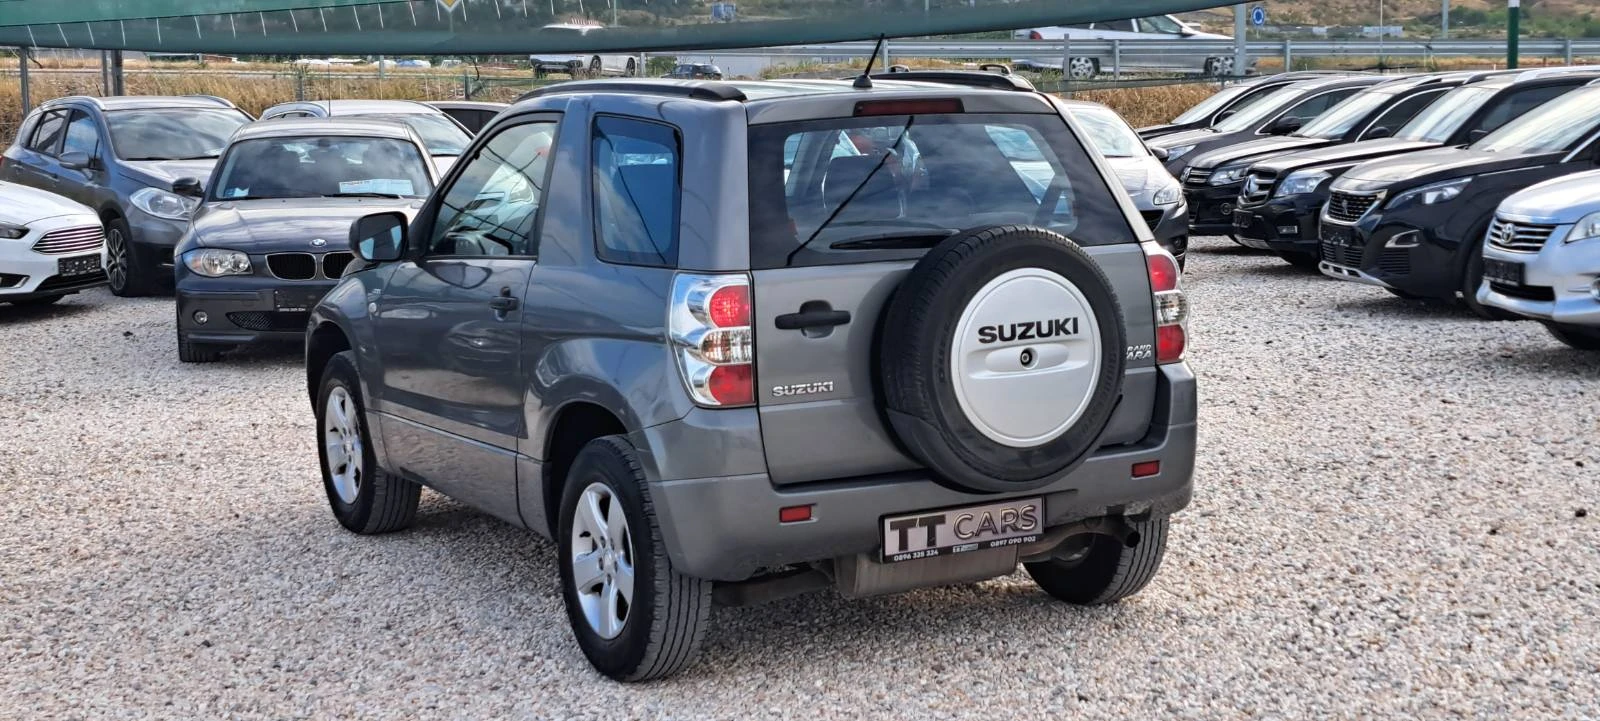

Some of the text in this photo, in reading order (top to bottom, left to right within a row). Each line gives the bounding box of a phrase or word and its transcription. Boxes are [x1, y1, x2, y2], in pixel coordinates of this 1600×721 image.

[977, 317, 1079, 344] SUZUKI
[1126, 350, 1152, 360] ARA
[772, 381, 834, 397] SUZUKI
[889, 504, 1038, 552] TT CARS
